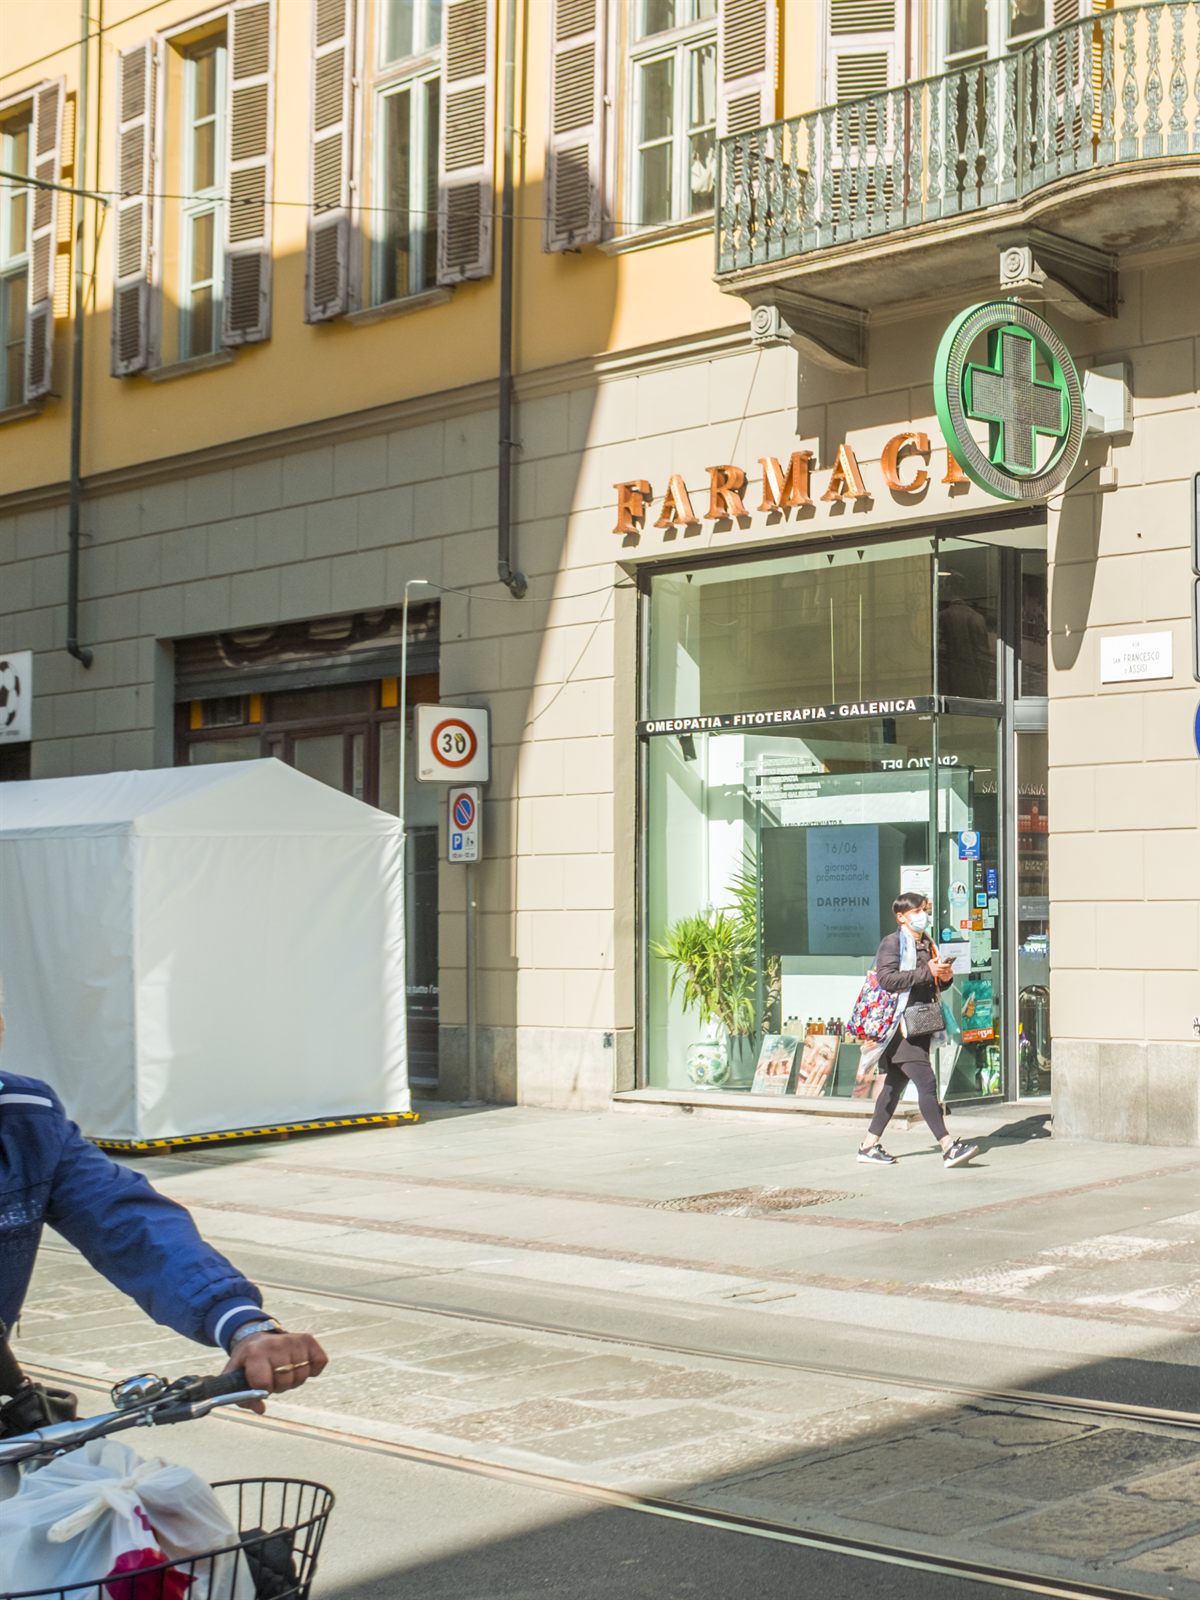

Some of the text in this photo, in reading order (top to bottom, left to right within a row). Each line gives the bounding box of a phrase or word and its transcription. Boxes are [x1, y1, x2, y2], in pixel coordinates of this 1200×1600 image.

[1123, 651, 1160, 662] FRANCESCO
[646, 717, 722, 733] OMEOPATIA
[733, 708, 826, 727] FITOTERAPIA
[839, 699, 916, 717] GALENICA
[442, 733, 466, 754] 30
[824, 843, 857, 856] 16/06
[824, 864, 857, 875] giornata
[816, 871, 869, 883] promozionale
[816, 897, 870, 907] DARPHIN
